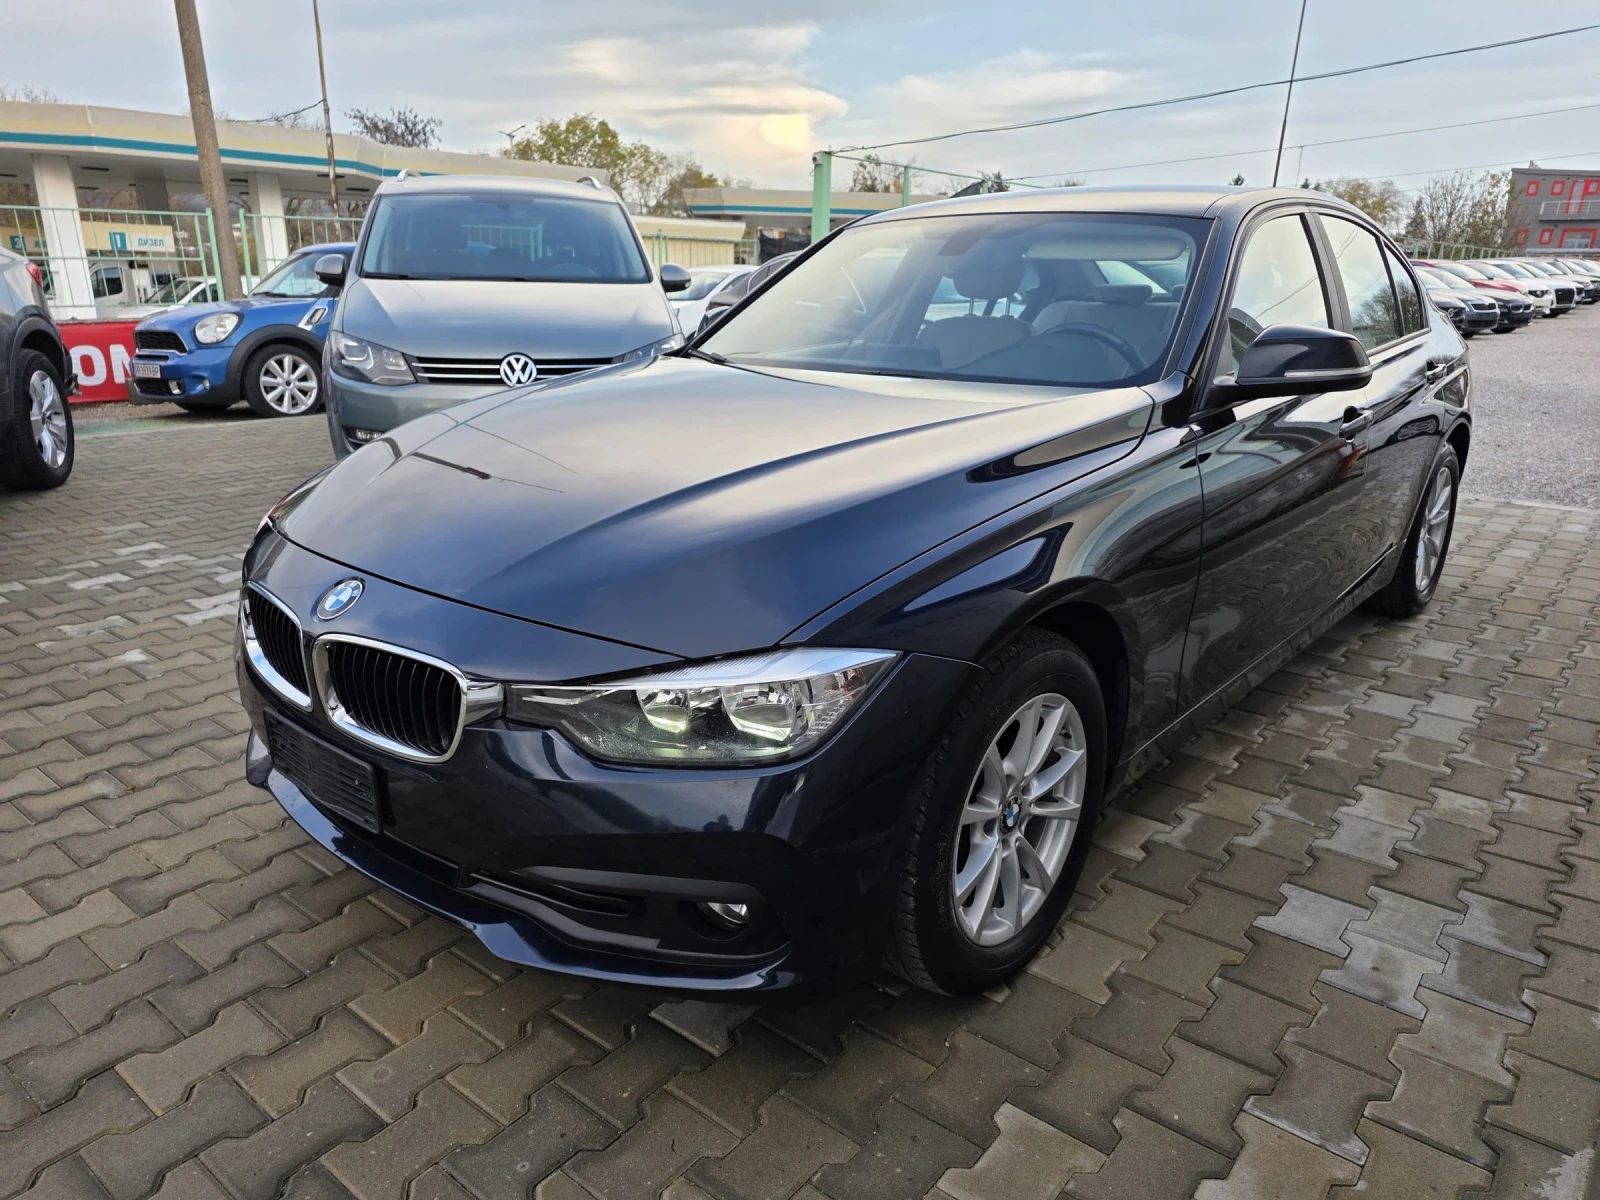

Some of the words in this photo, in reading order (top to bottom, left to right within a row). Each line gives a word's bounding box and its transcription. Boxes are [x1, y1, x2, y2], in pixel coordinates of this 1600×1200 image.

[115, 234, 122, 248] 1
[138, 237, 164, 247] ДИЗЕЛ
[501, 354, 537, 384] VW
